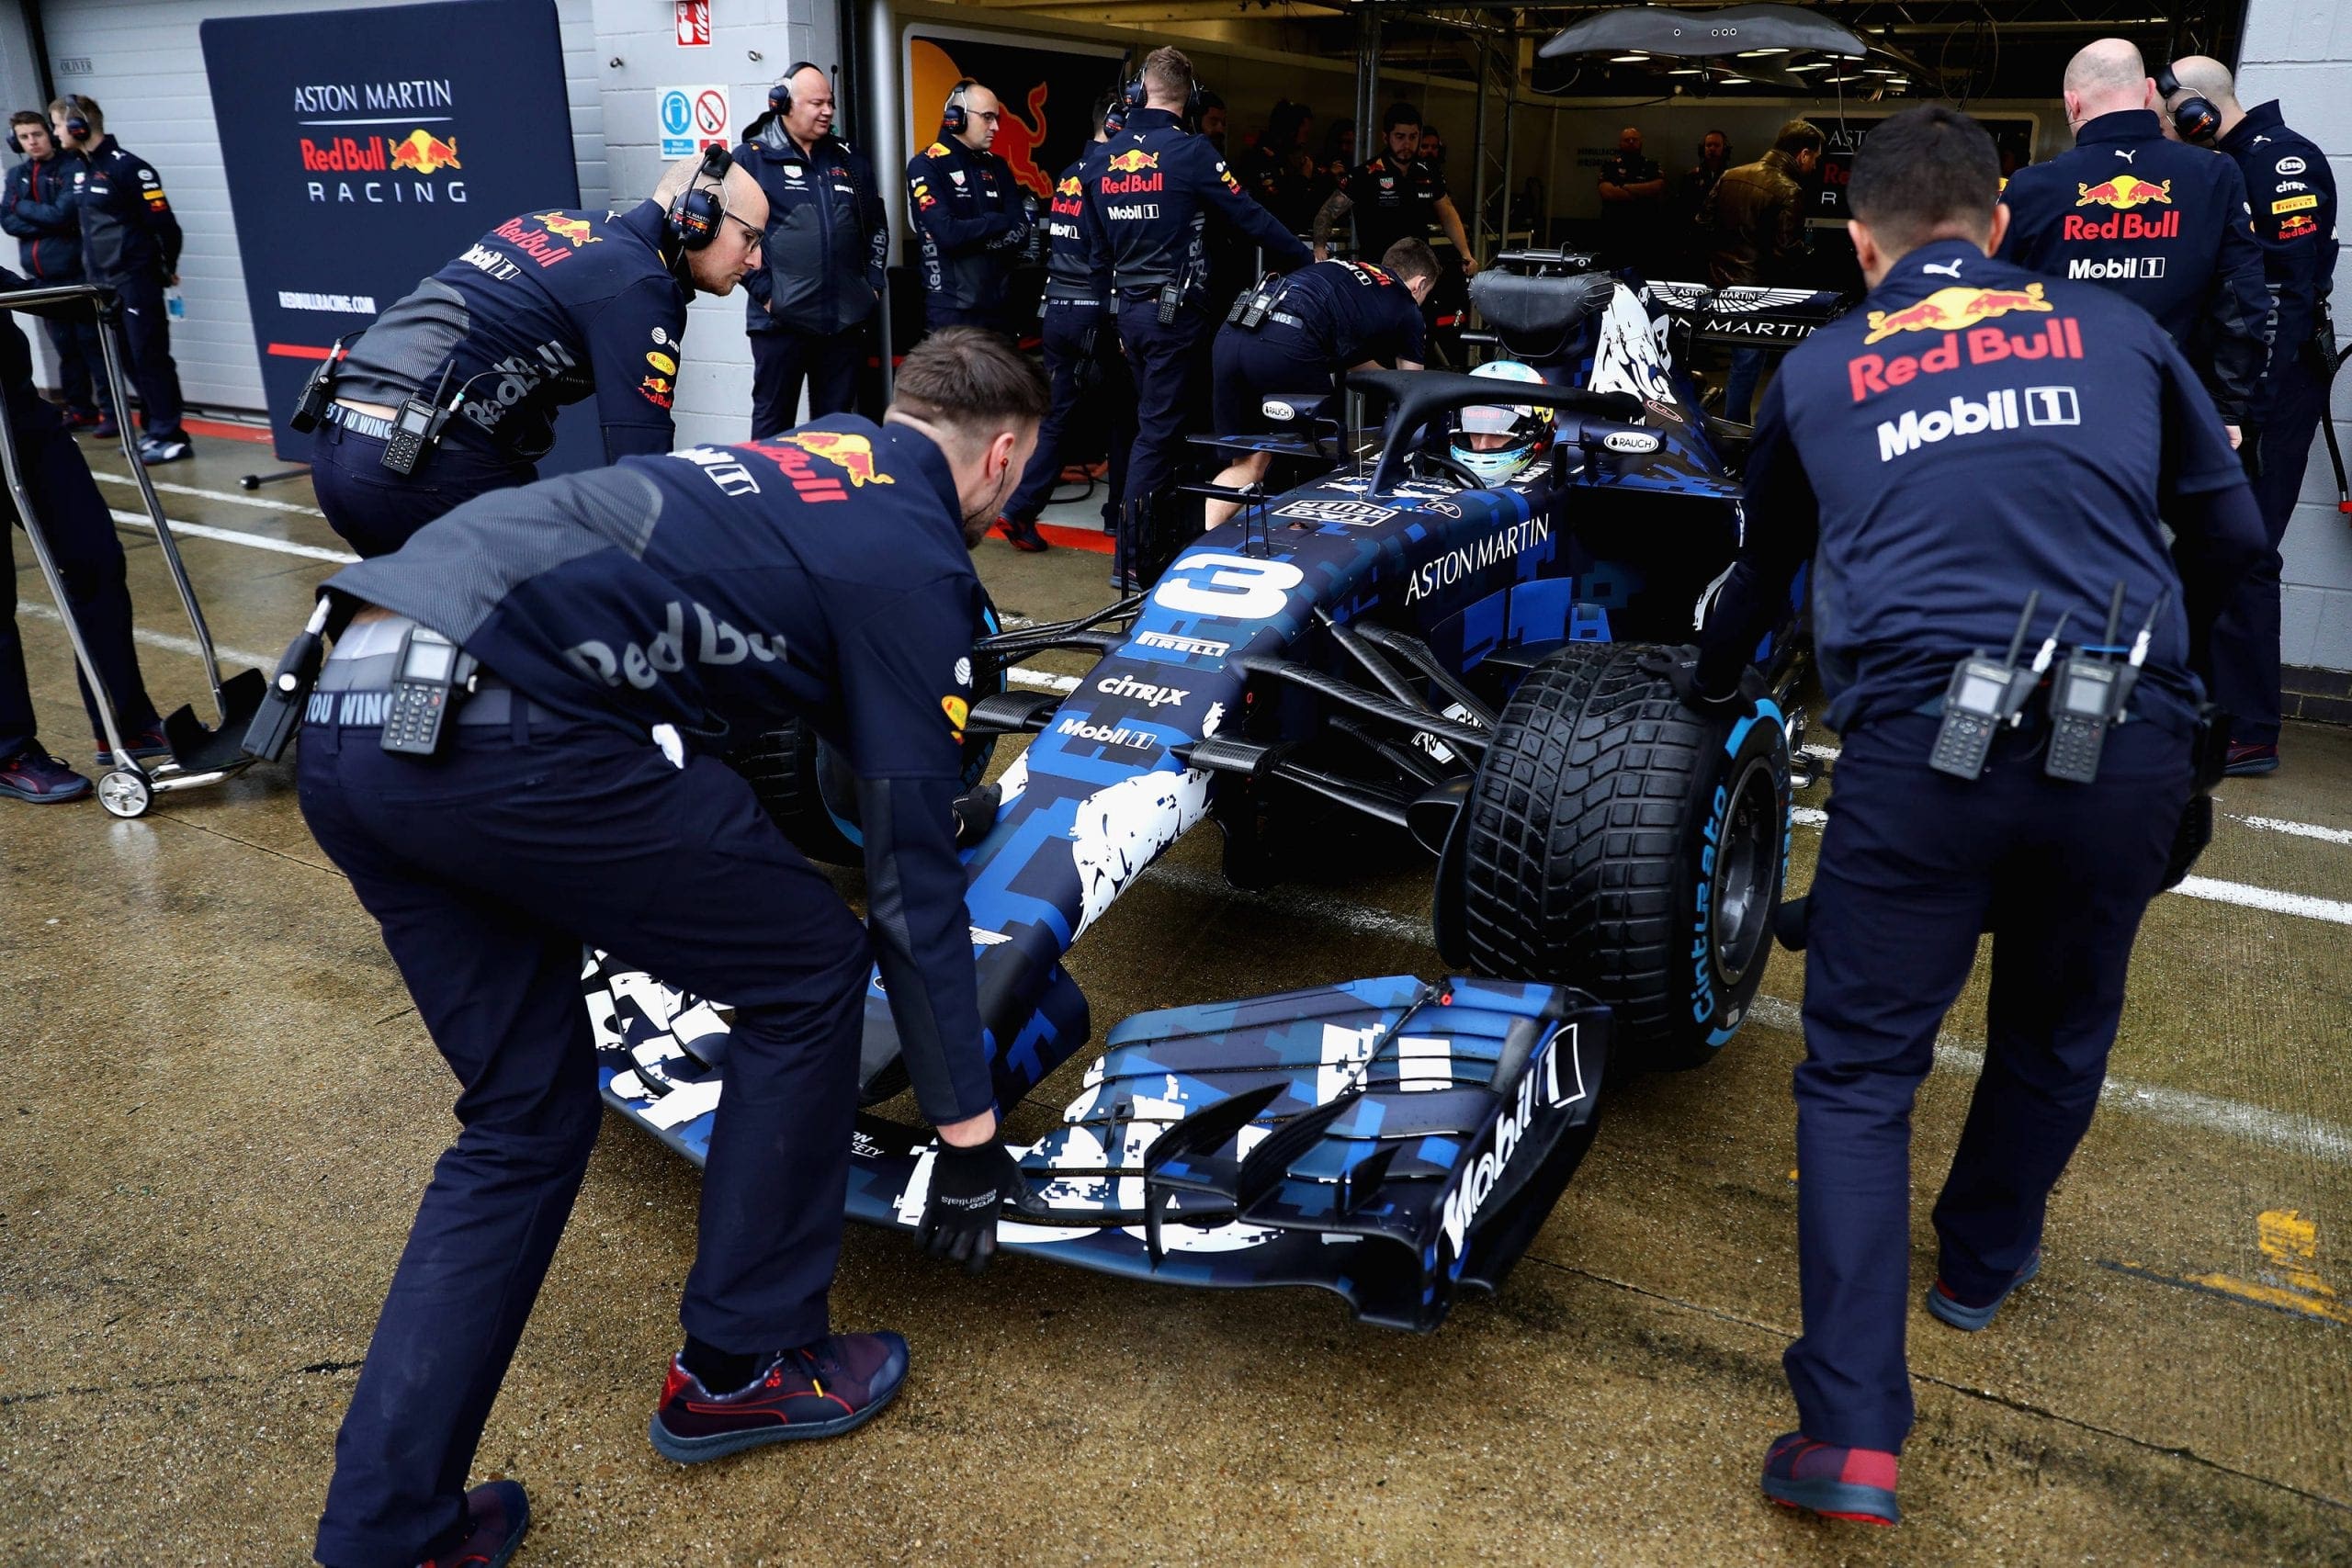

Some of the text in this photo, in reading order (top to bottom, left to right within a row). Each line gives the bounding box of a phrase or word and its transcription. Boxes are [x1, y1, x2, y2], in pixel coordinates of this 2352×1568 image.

[294, 79, 453, 112] ASTON MARTIN
[300, 136, 386, 172] Red Bull
[308, 182, 467, 202] RACING
[1102, 173, 1163, 195] Red Bull
[1107, 205, 1142, 220] Mobil
[2064, 210, 2179, 241] Red Bull
[2278, 223, 2317, 241] Red Bull
[517, 229, 573, 268] Bull
[2068, 258, 2137, 280] Mobil
[1719, 291, 1757, 301] MARTIN
[1849, 317, 2084, 402] Red Bull
[1269, 406, 1290, 417] RAUCH
[1877, 389, 2018, 462] Mobil
[1619, 437, 1652, 449] RAUCH
[1405, 513, 1549, 606] ASTON MARTIN
[1153, 553, 1305, 619] 3
[1135, 630, 1230, 658] PIRELLI
[304, 693, 334, 724] YOU
[1057, 718, 1131, 745] Mobil
[1690, 784, 1727, 1024] Cinturato
[1442, 1067, 1535, 1259] Mobil
